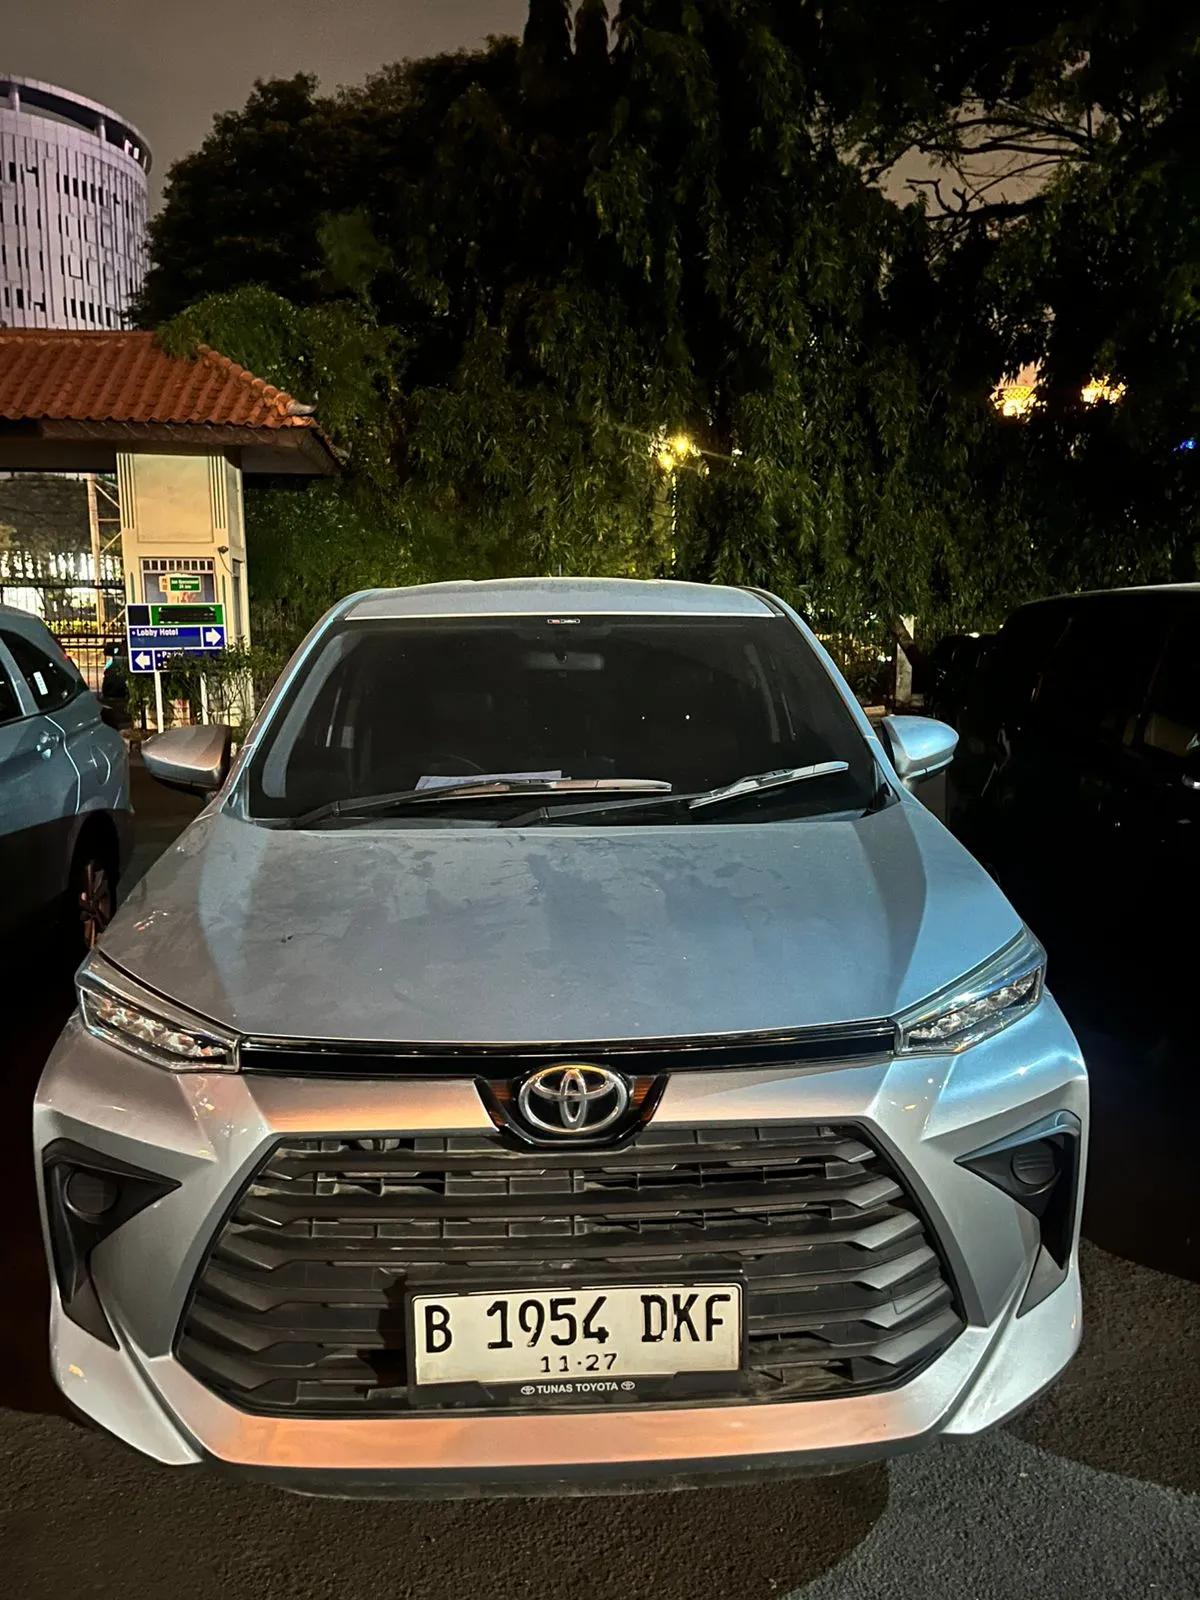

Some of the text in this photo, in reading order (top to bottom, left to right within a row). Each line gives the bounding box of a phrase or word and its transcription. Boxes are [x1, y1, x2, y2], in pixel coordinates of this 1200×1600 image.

[136, 628, 179, 638] Lobby Hotel
[424, 1293, 732, 1354] B 1954 DKF
[536, 1382, 619, 1394] TUNAS TOYOTA
